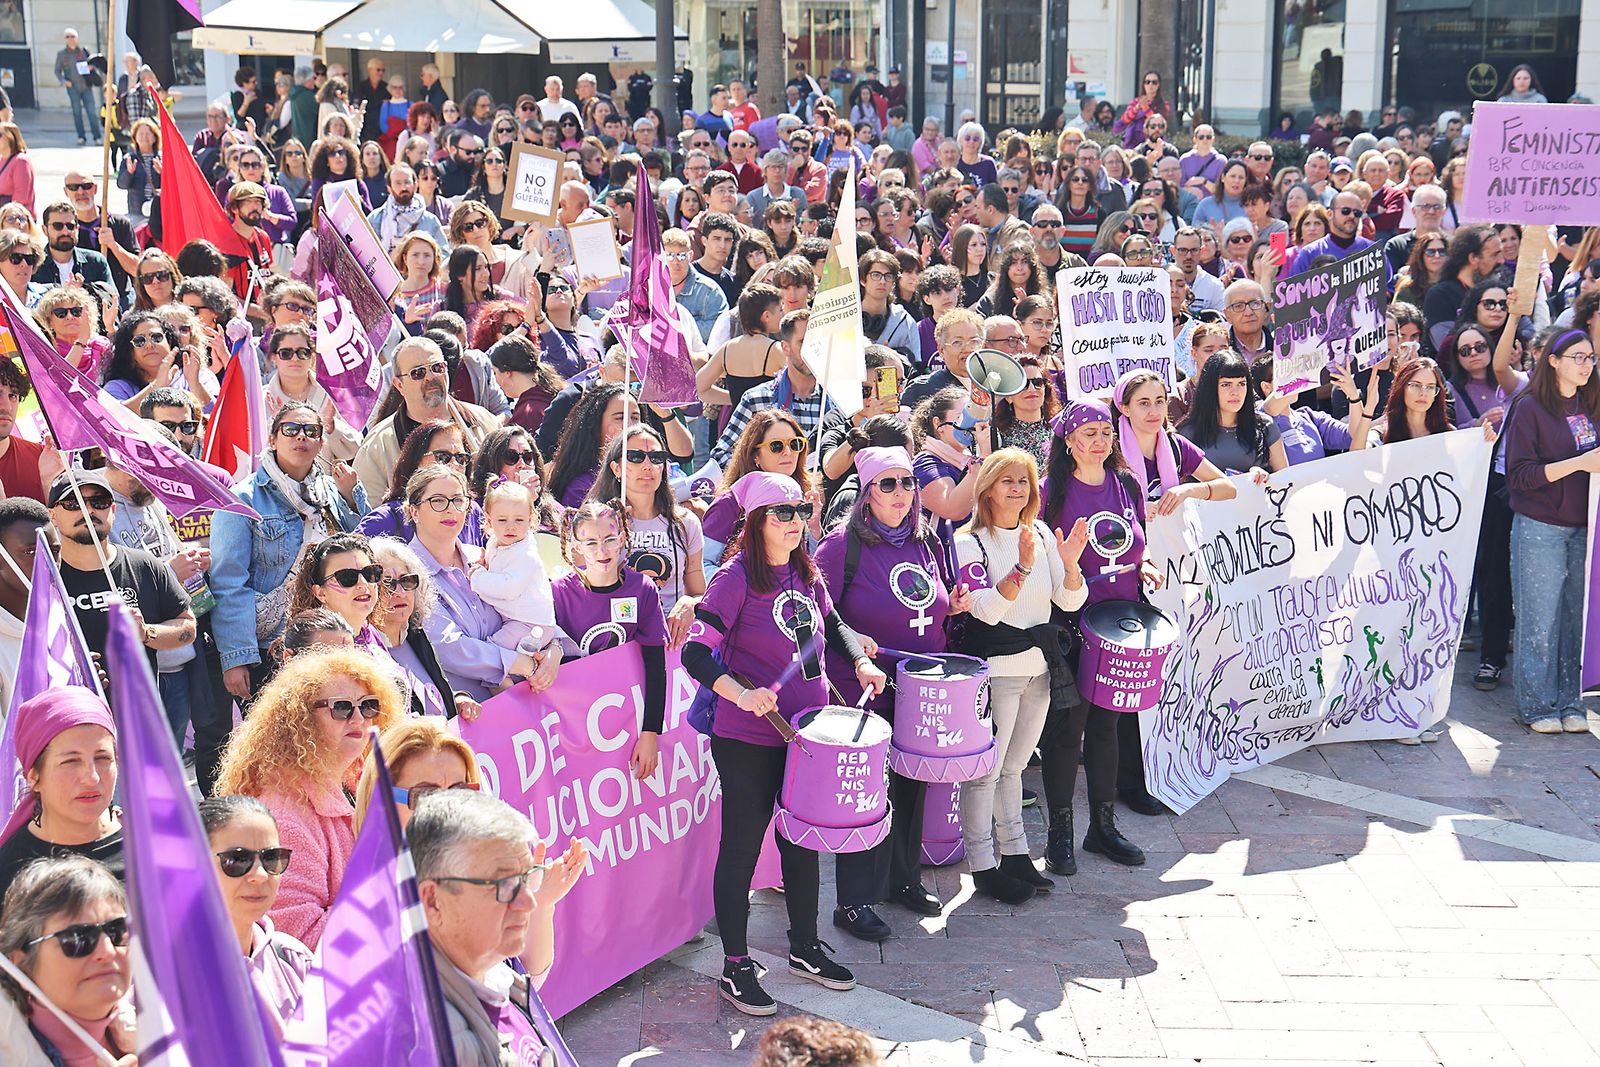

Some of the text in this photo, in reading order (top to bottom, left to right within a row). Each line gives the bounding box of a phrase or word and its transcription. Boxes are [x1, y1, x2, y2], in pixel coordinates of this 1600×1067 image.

[525, 173, 546, 188] NO
[515, 192, 549, 206] GUERRA
[533, 188, 543, 196] LA
[1071, 269, 1108, 291] estoy
[1274, 272, 1329, 309] SOMOS
[1343, 251, 1375, 285] HIJAS
[1071, 287, 1166, 326] HASTA EL COÑO
[1079, 361, 1116, 394] UNA
[1312, 471, 1462, 552] NI GYMBROS
[1166, 515, 1296, 590] NI TRADWIVES
[1108, 657, 1152, 669] JUNTAS
[1109, 667, 1149, 679] SOMOS
[1095, 673, 1157, 690] IMPARABLES
[919, 686, 948, 700] RED
[1112, 690, 1142, 708] 8M
[919, 701, 952, 715] FEMI
[922, 714, 944, 727] NIS
[915, 724, 931, 738] TA
[511, 711, 567, 794] DE
[837, 751, 869, 765] RED
[836, 764, 871, 778] FEMI
[841, 779, 865, 791] NIS
[835, 792, 854, 805] TA
[579, 784, 711, 877] MUNDO
